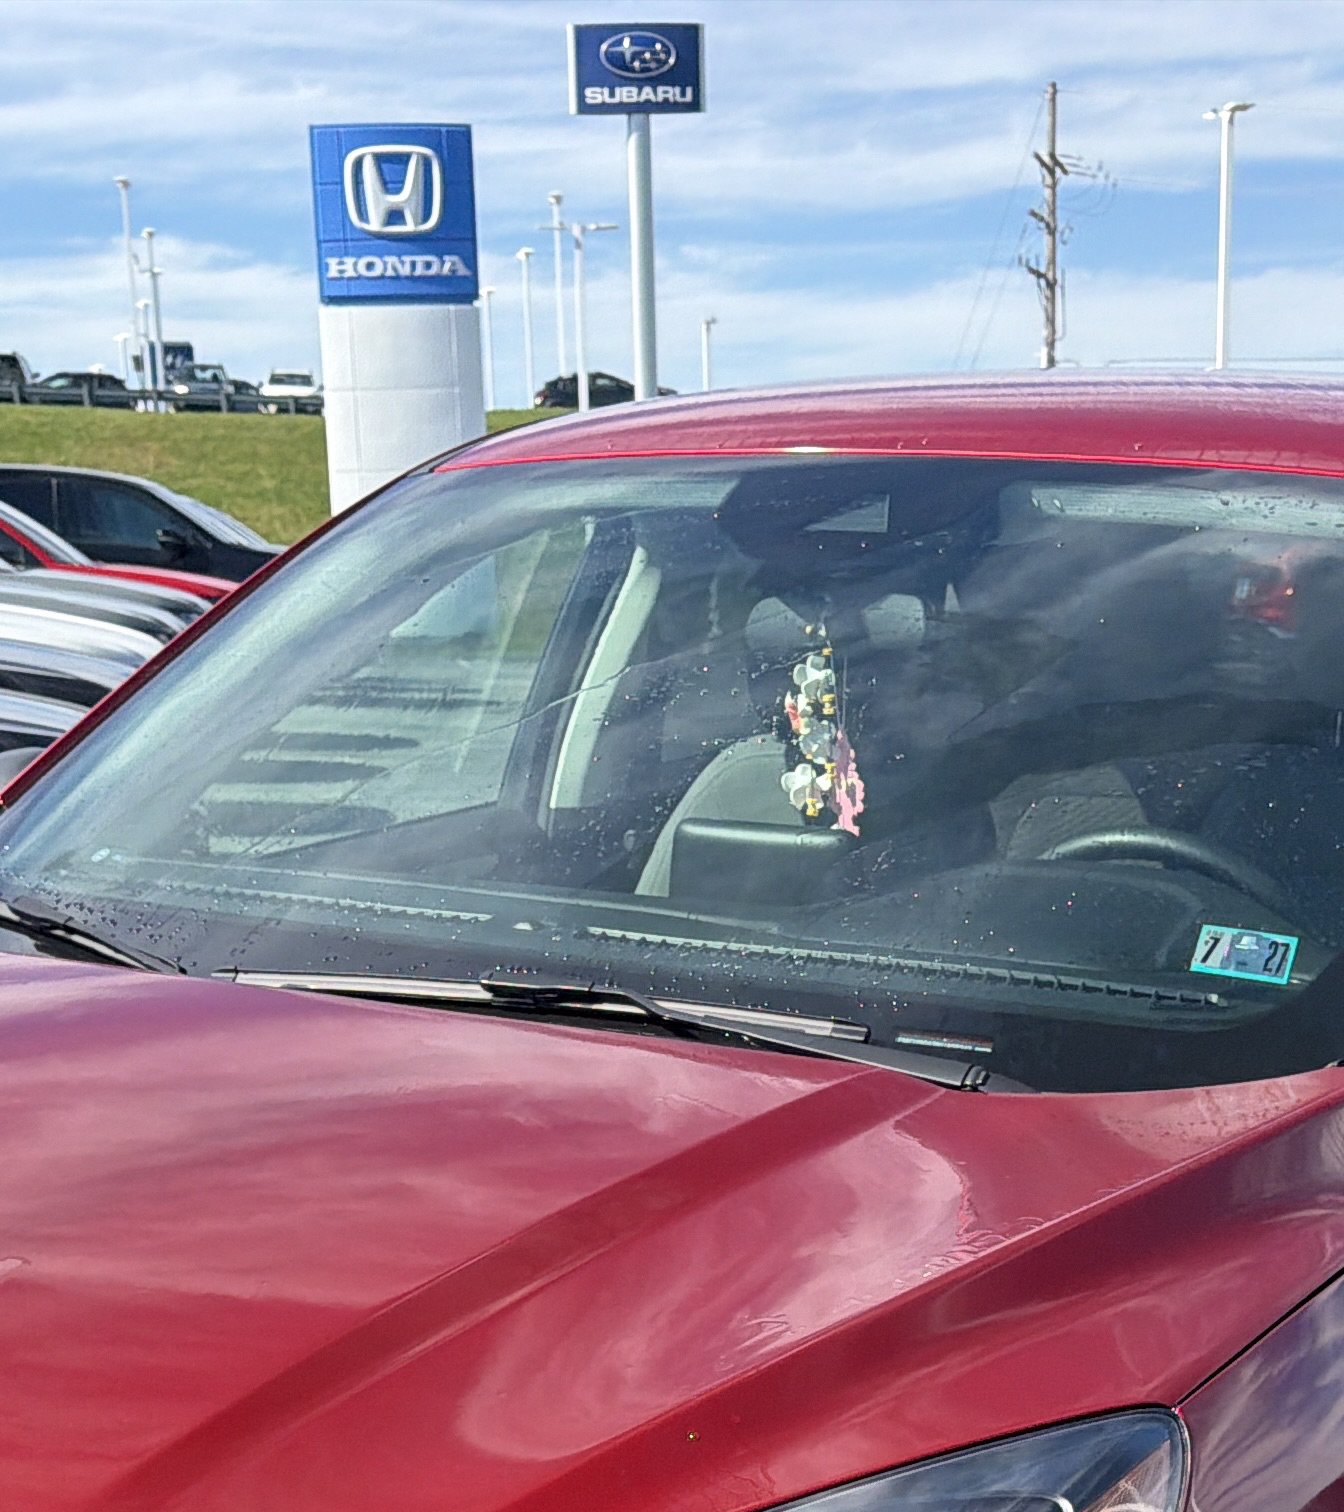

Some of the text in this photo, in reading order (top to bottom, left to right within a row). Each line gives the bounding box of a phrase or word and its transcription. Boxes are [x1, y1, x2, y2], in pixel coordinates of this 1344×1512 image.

[584, 85, 693, 105] SUBARU
[325, 254, 472, 280] HONDA
[1201, 936, 1291, 976] 7 27
